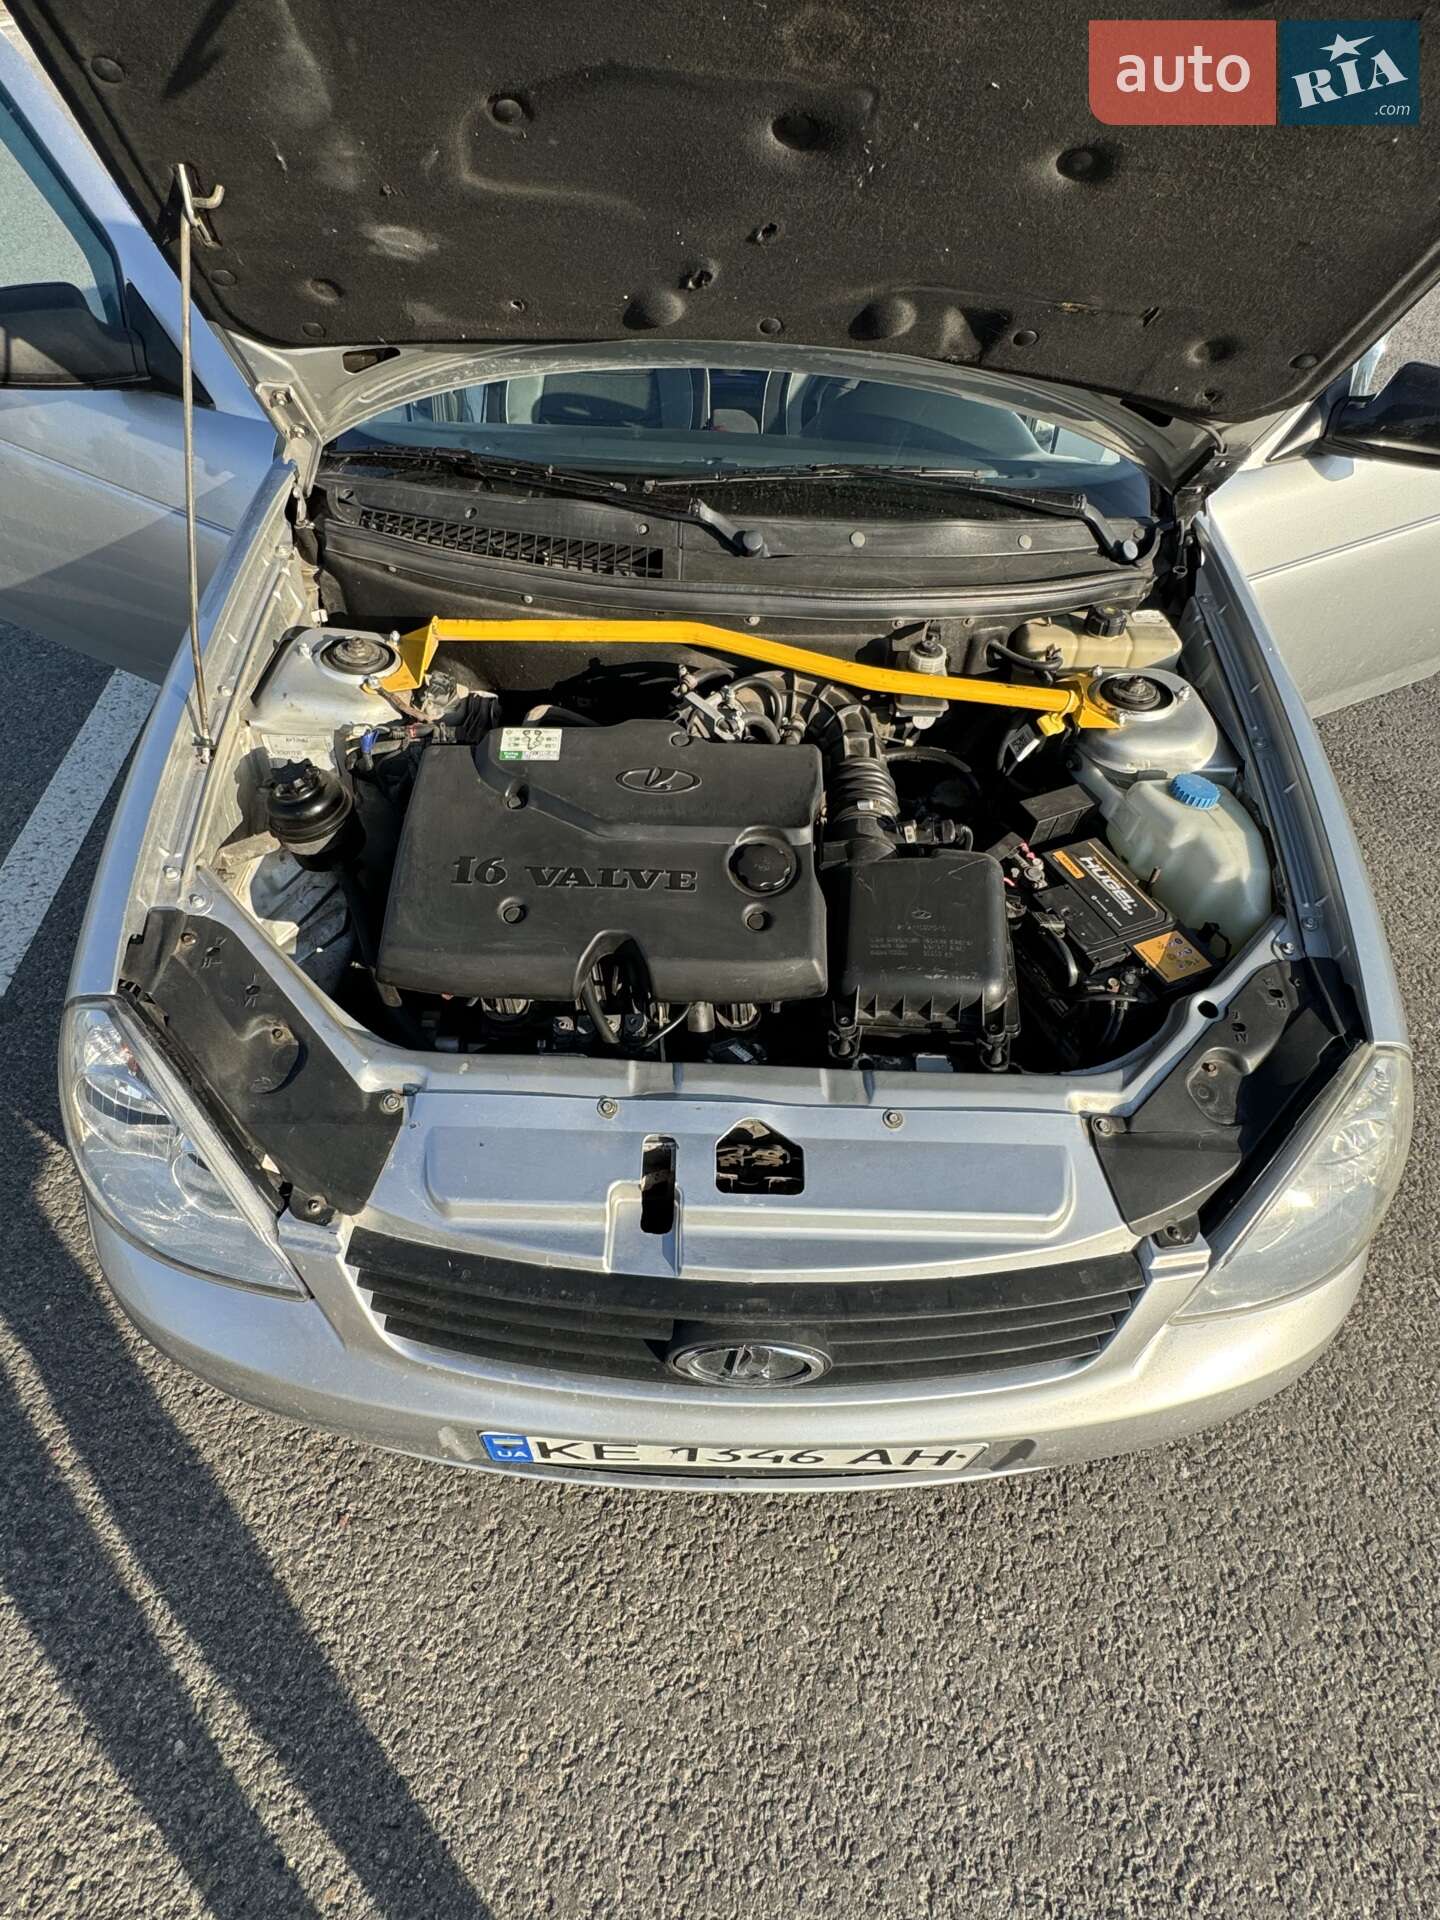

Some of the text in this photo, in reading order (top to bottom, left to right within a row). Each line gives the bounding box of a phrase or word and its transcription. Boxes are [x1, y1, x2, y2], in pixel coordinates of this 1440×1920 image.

[450, 855, 698, 893] 16 VALVE
[1079, 856, 1136, 909] HUGEL
[497, 1450, 529, 1458] UA
[536, 1441, 957, 1466] KE 1346 AH
